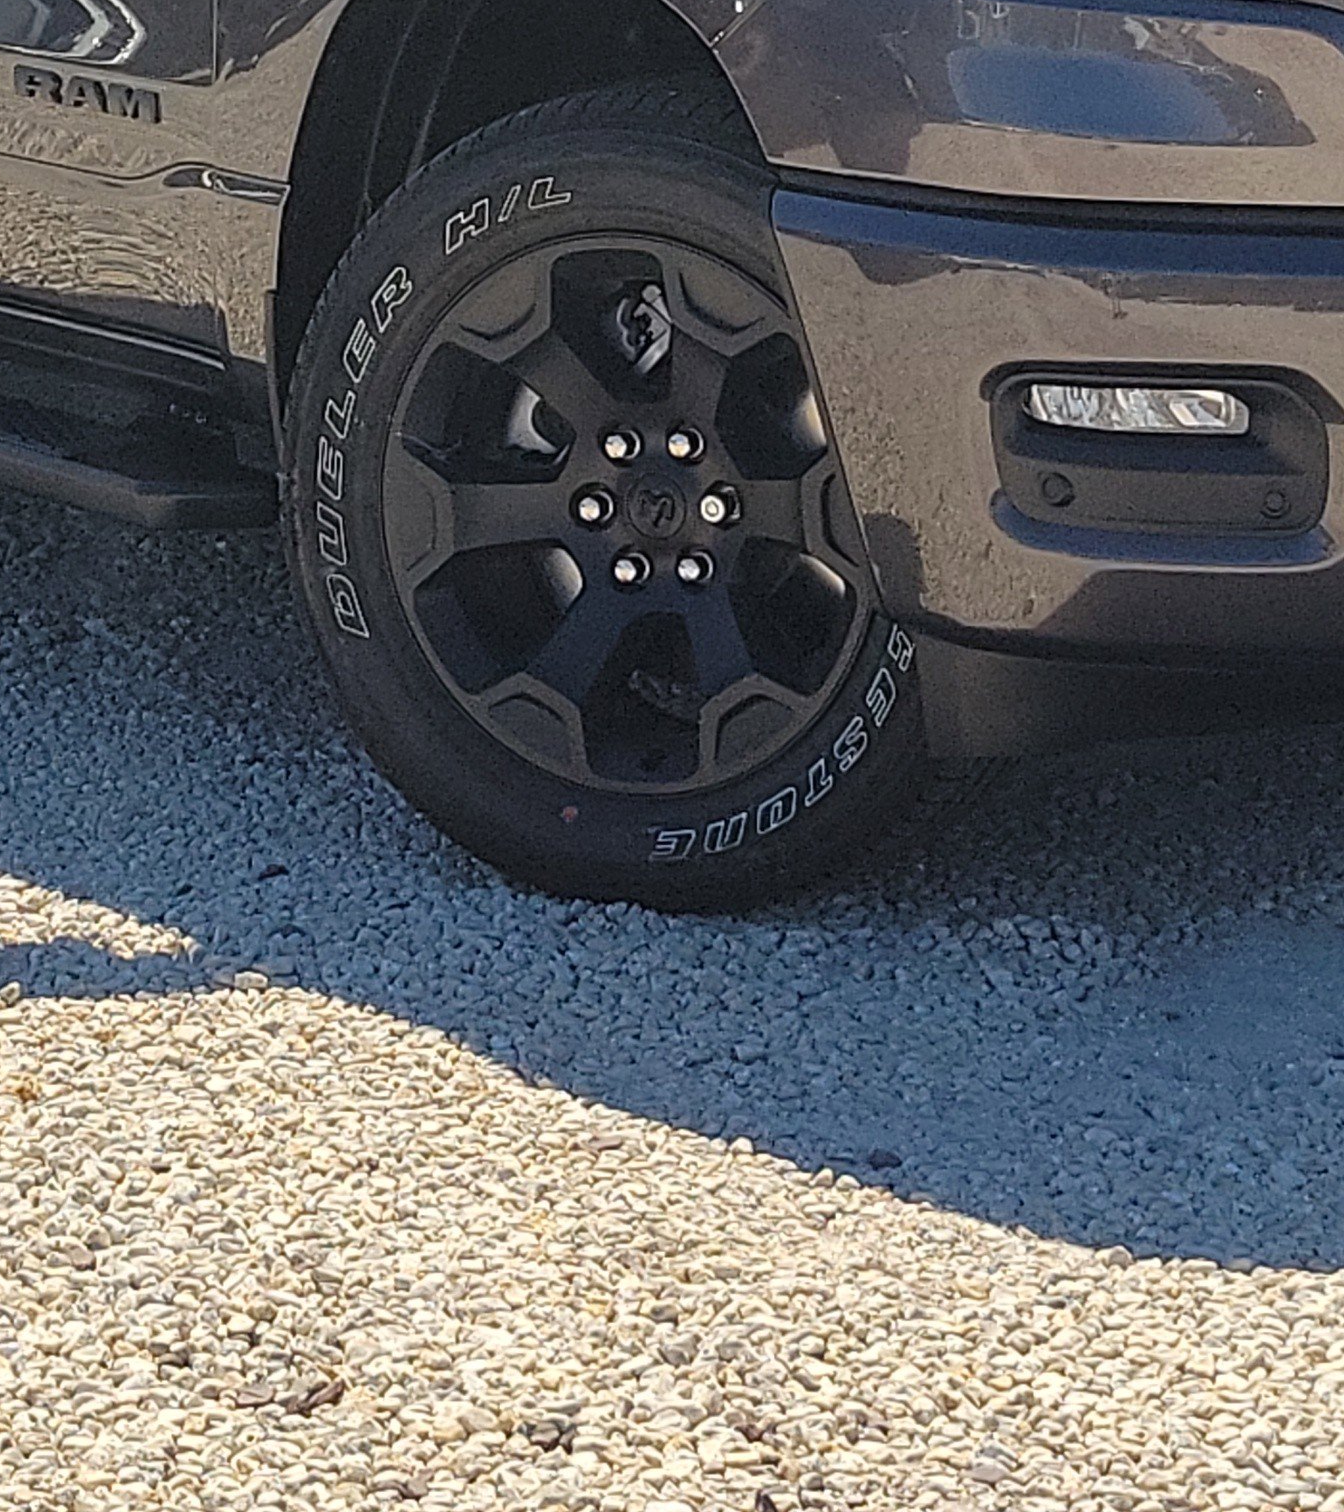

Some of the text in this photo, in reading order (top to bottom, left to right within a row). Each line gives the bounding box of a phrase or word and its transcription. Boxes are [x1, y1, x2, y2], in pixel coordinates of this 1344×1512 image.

[14, 64, 162, 124] RAM
[317, 176, 572, 639] DUELER H/L
